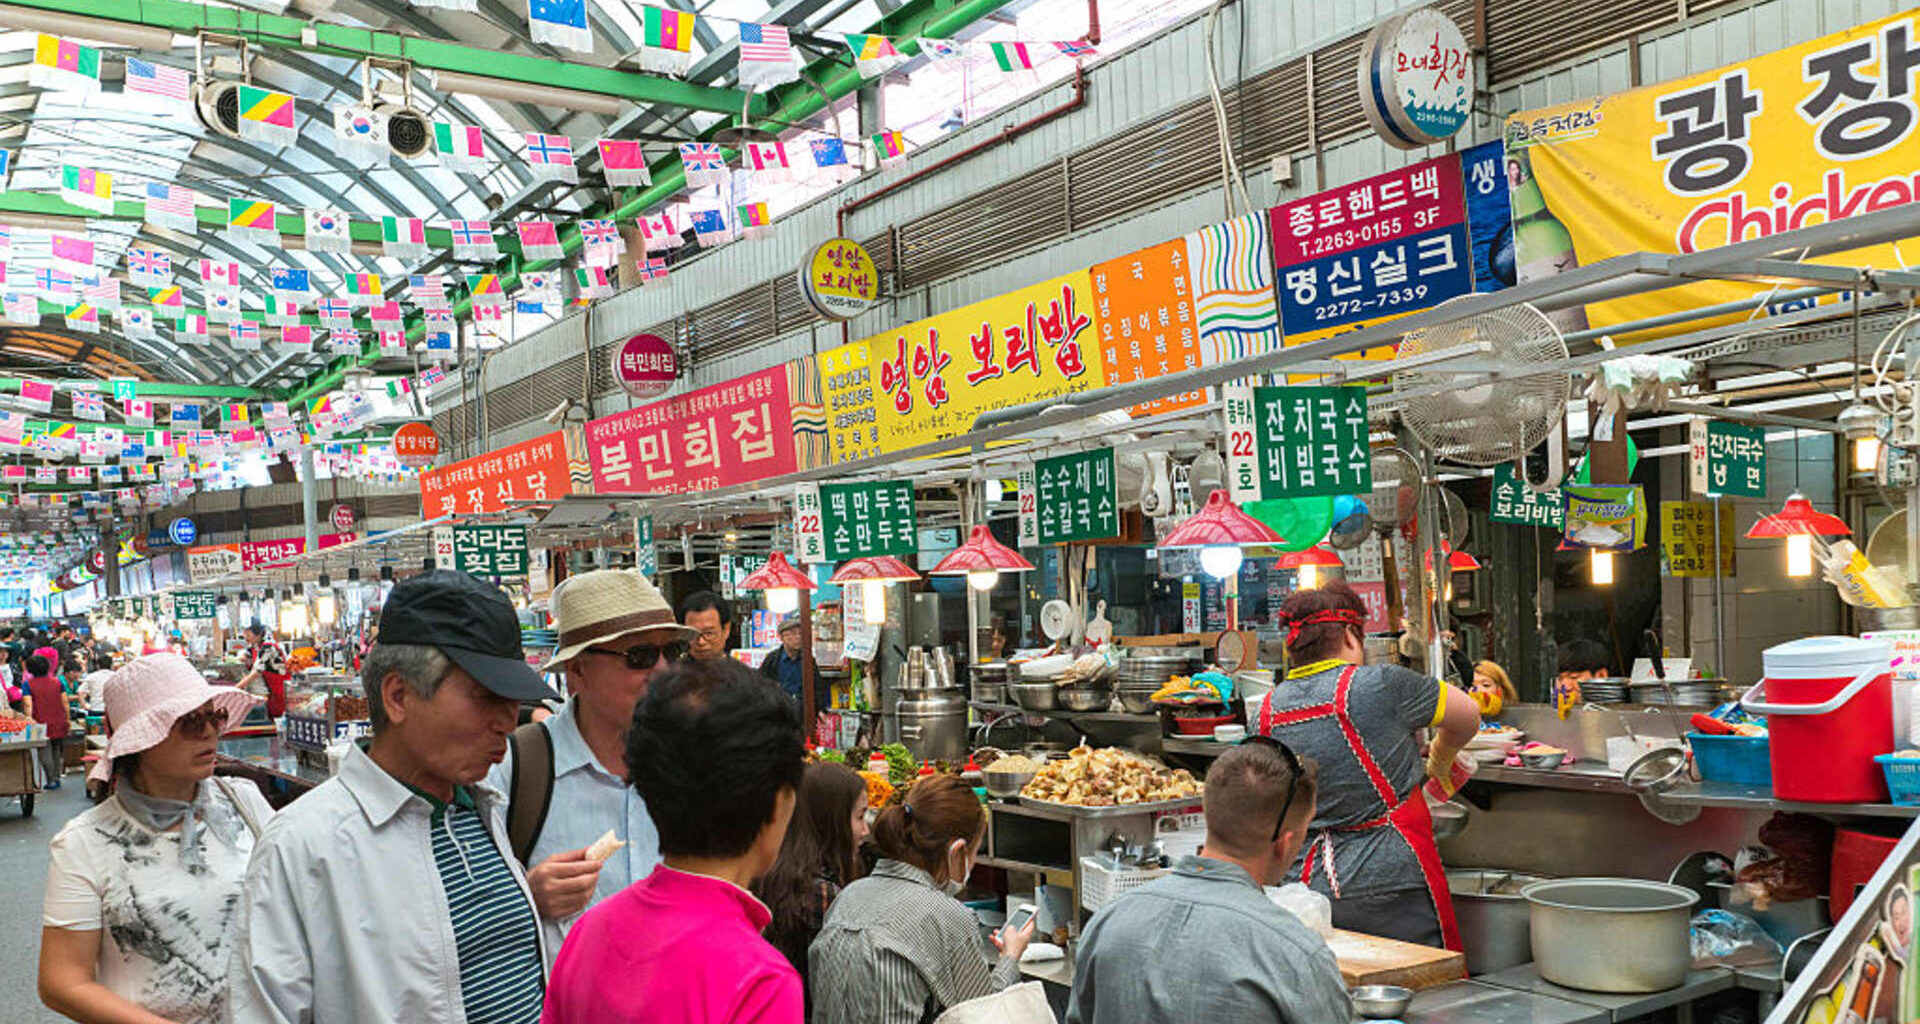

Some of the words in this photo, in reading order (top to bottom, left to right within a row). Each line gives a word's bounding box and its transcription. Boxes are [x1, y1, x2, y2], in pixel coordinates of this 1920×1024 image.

[1472, 158, 1495, 194] 생
[1289, 166, 1440, 237] 종로핸드백
[1680, 172, 1920, 254] Chicke
[1413, 206, 1440, 228] 3F
[826, 245, 864, 269] 영암
[1286, 234, 1458, 306] 명신실크
[817, 271, 872, 297] 보리밥
[1314, 284, 1428, 321] 2272-7339
[624, 352, 674, 373] 복민회집
[880, 328, 951, 413] 영암
[966, 284, 1091, 385] 보리밥
[1265, 397, 1364, 442] 잔치국수
[600, 402, 776, 487] 복민회집
[1231, 430, 1254, 457] 22
[1709, 433, 1763, 463] 잔치국수
[1040, 456, 1111, 500] 손수제비
[1238, 463, 1255, 490] 호
[1267, 442, 1367, 490] 비빔국수
[440, 470, 547, 515] 광장식당
[831, 487, 910, 522] 떡만두국
[1021, 493, 1035, 515] 22
[1496, 482, 1563, 506] 손칼국
[800, 514, 820, 533] 22
[1024, 517, 1035, 538] 호
[1042, 494, 1113, 537] 손칼국수
[438, 543, 452, 555] 23
[455, 528, 526, 552] 전라도
[805, 536, 821, 556] 호
[833, 518, 914, 554] 손만두국
[464, 552, 520, 573] 횟집
